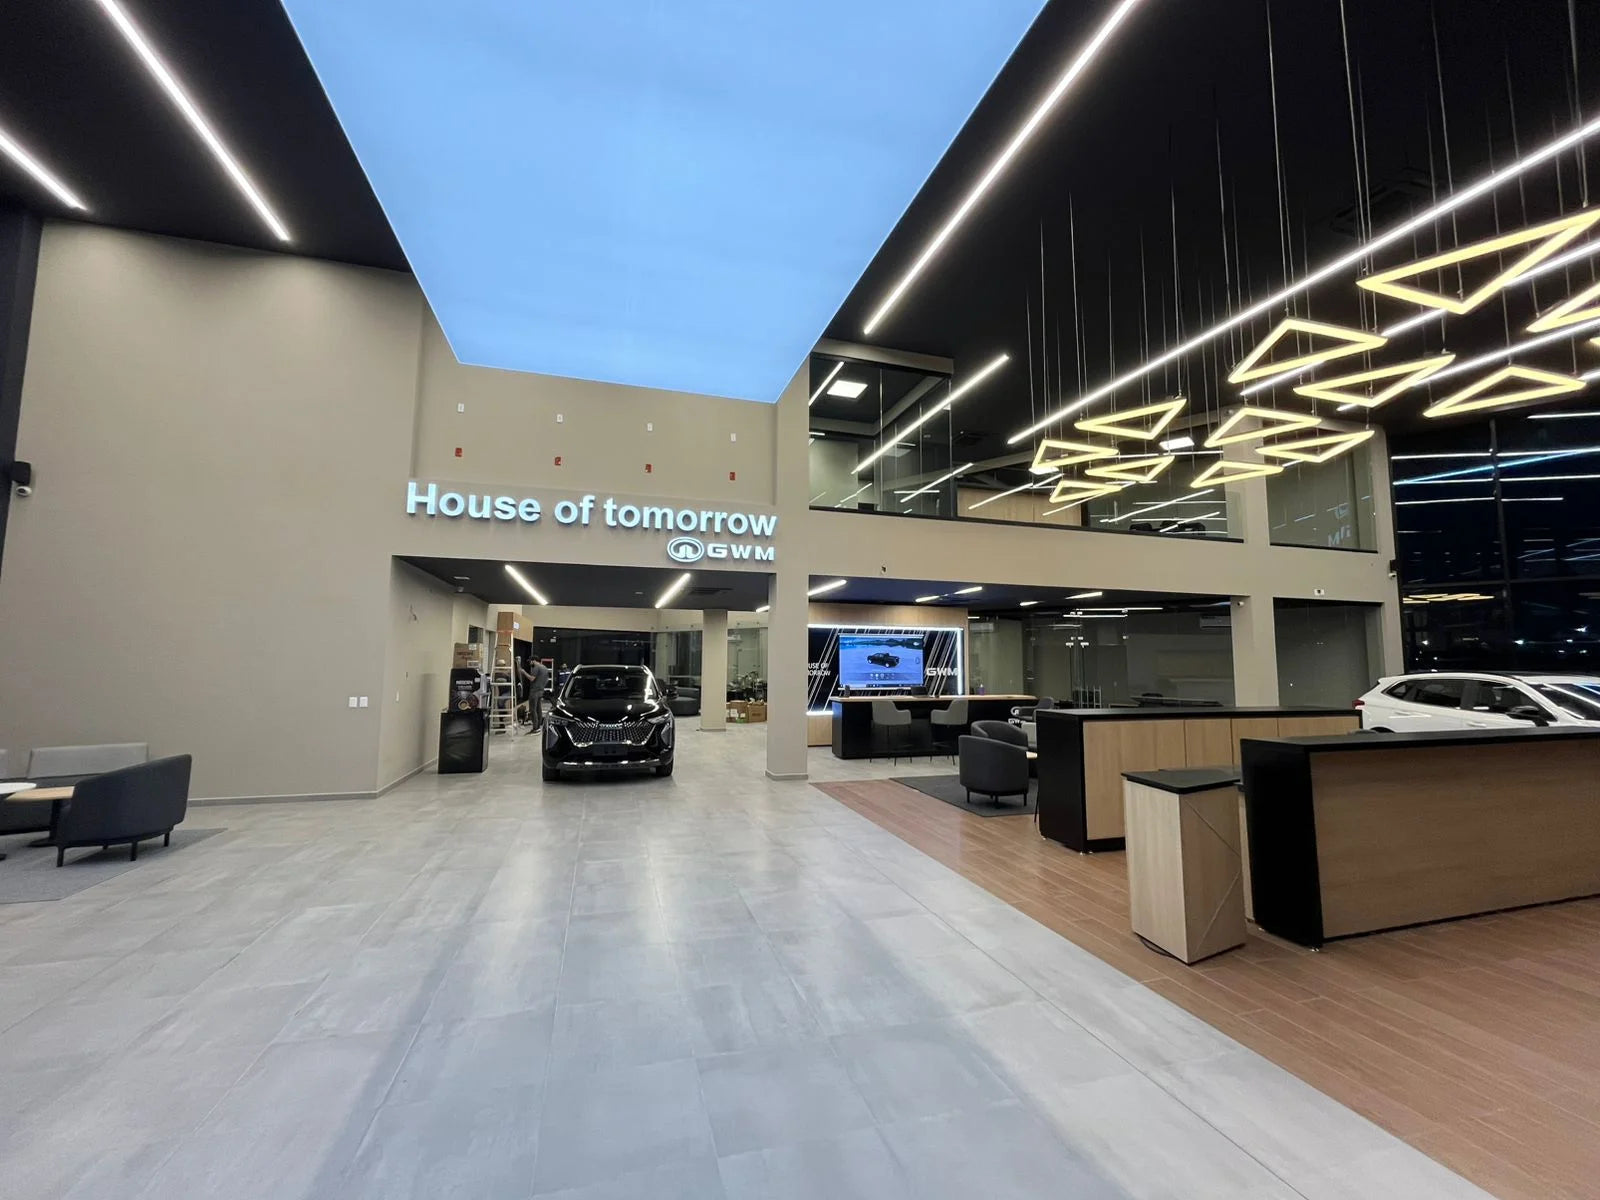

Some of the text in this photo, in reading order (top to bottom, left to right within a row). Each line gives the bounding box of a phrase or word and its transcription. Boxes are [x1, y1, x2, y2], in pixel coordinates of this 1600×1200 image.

[406, 481, 777, 536] House of tomorrow
[707, 542, 775, 561] GWM
[926, 667, 958, 676] GWM
